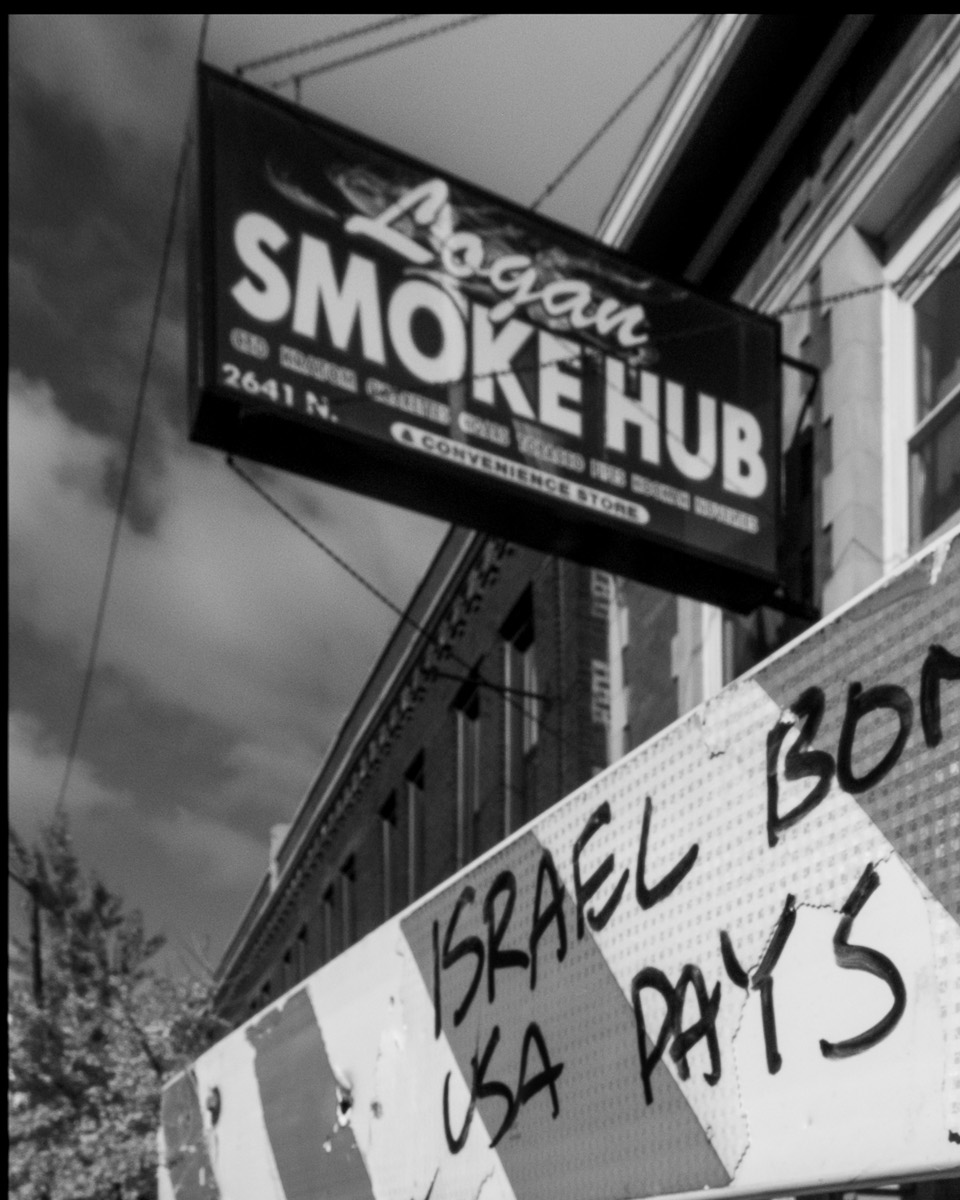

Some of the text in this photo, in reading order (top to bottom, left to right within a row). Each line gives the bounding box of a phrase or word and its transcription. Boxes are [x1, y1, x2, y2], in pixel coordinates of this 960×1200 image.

[231, 211, 768, 499] SMOKE HUB
[344, 178, 650, 347] Logan
[221, 362, 294, 408] 2641
[422, 435, 570, 497] CONVENIENCE
[577, 488, 639, 520] STORE
[433, 796, 699, 1040] ISRAEL
[443, 862, 907, 1154] USA PAYS
